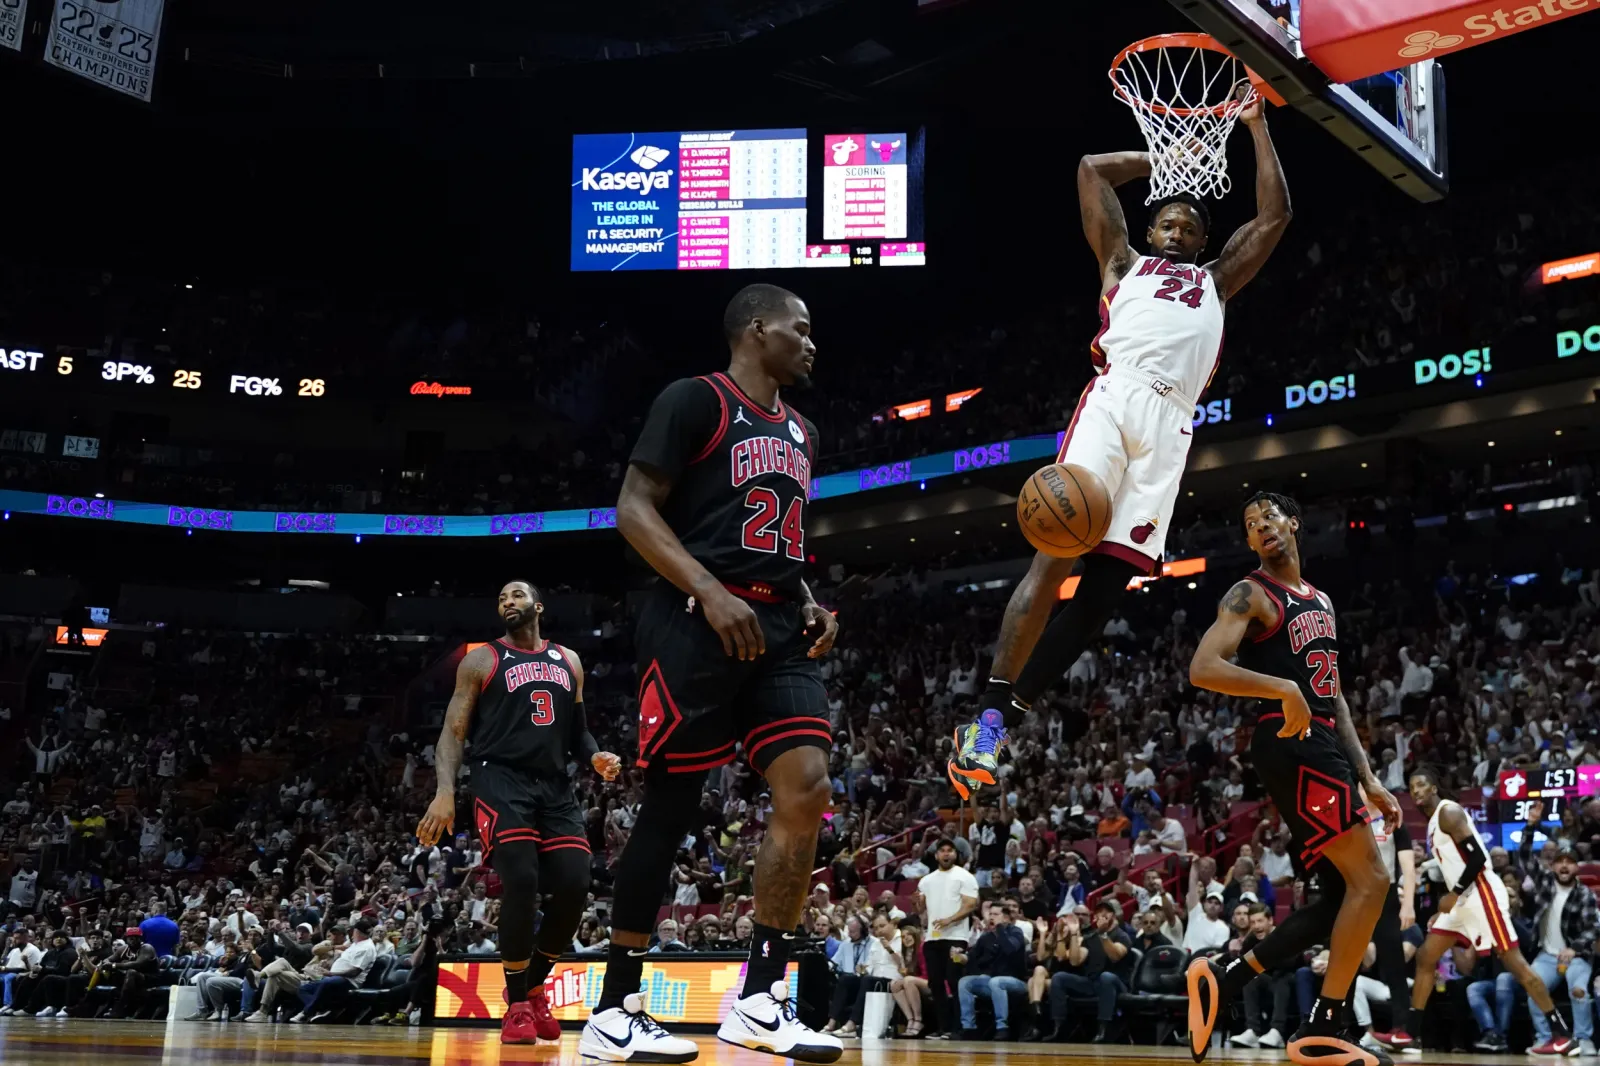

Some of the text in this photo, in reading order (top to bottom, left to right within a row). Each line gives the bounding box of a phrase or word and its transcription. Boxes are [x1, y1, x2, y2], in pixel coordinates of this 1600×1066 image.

[60, 1, 95, 43] 22
[118, 26, 153, 64] 23
[1463, 0, 1590, 39] State
[52, 45, 148, 95] CHAMPIONS
[56, 33, 95, 56] EASTERN
[97, 51, 151, 77] CONFERENCE
[582, 167, 669, 195] Kaseya
[845, 167, 886, 177] SCORING
[591, 200, 660, 212] THE GLOBAL
[597, 214, 654, 226] LEADER IN
[585, 242, 665, 254] MANAGEMENT
[587, 228, 664, 240] IT & SECURITY
[1135, 257, 1208, 288] HEAT
[1153, 277, 1205, 309] 24
[1556, 324, 1600, 358] DO
[57, 356, 74, 375] 5
[101, 361, 155, 384] 3P%
[172, 369, 202, 389] 25
[229, 374, 283, 396] FG%
[298, 378, 325, 397] 26
[1414, 346, 1492, 385] DOS!
[409, 381, 472, 398] Bally SPORTS
[1284, 373, 1356, 409] DOS!
[1191, 397, 1232, 428] OS!
[953, 441, 1010, 473] DOS!
[859, 460, 912, 490] DOS!
[46, 494, 115, 520] DOS!
[1040, 466, 1077, 520] Wilson
[167, 505, 234, 531] DOS!
[275, 511, 336, 533] DOS!
[383, 514, 445, 535] DOS!
[490, 511, 544, 535] DOS!
[588, 507, 617, 529] DO
[741, 485, 805, 562] 24
[1287, 609, 1337, 655] CHICA
[504, 661, 571, 693] CHICAGO
[529, 689, 555, 726] 3
[1544, 768, 1575, 788] 1:57
